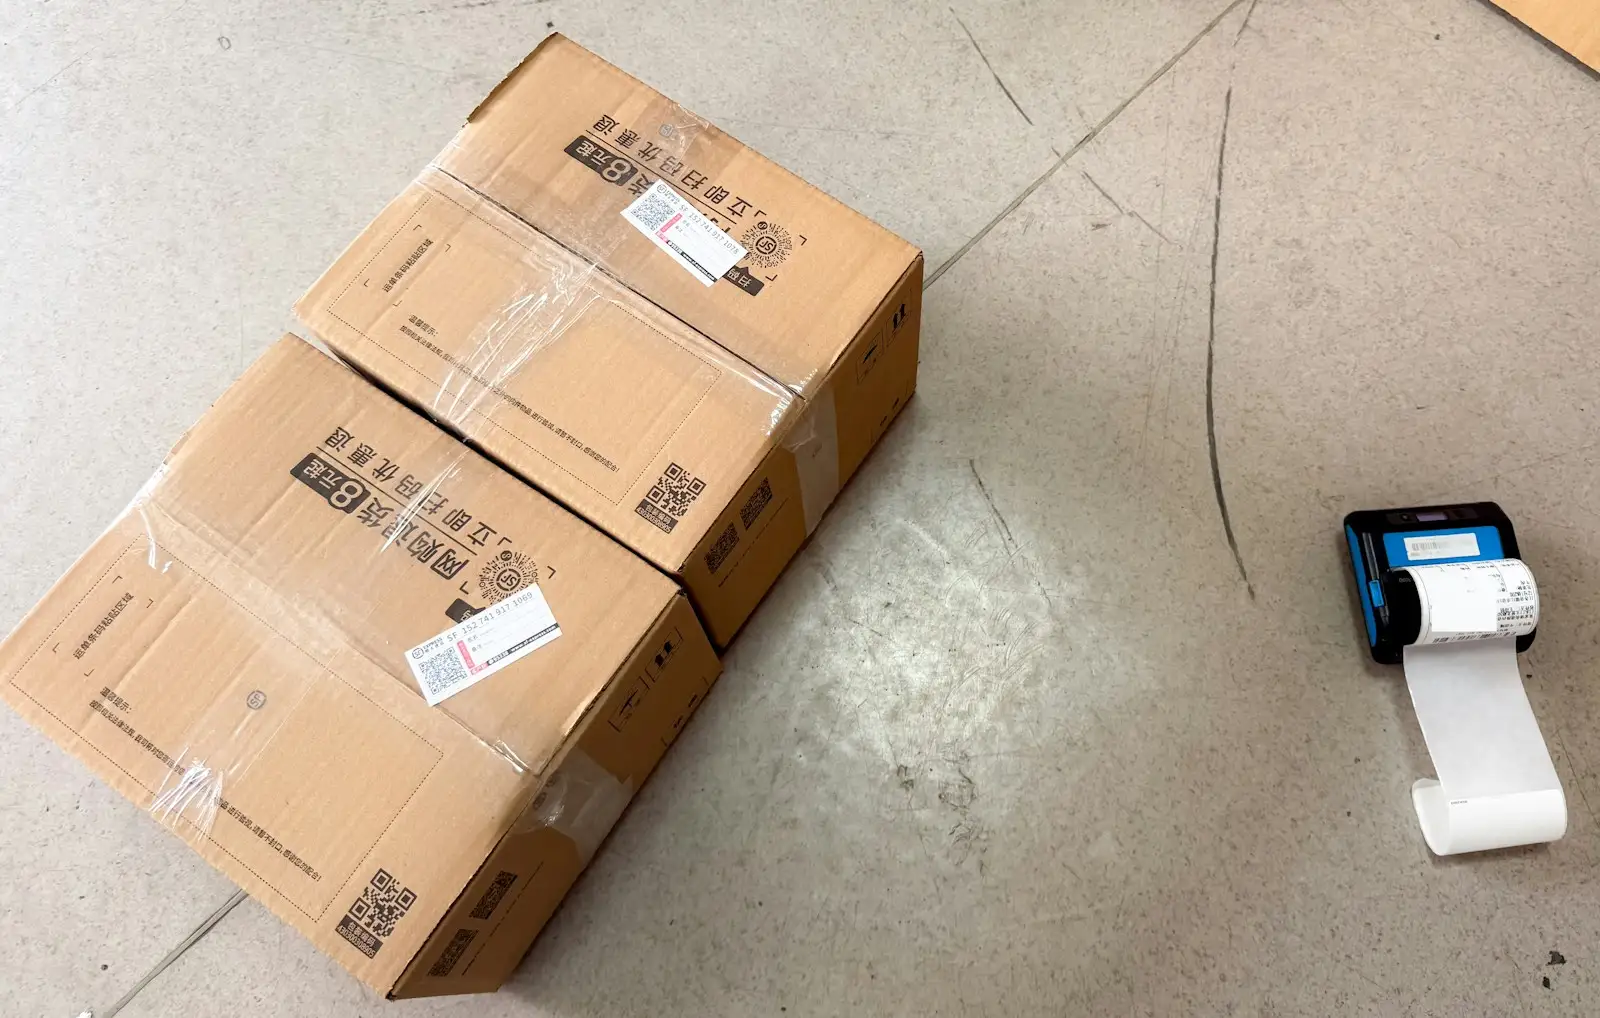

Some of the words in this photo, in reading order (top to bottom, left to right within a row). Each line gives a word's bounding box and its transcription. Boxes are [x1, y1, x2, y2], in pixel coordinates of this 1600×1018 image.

[593, 114, 752, 217] 立即扫码优惠退
[679, 205, 688, 213] SF
[689, 212, 702, 223] 152
[702, 221, 713, 231] 741
[712, 230, 724, 241] 917
[382, 238, 434, 292] 运单条码粘贴区域
[325, 426, 497, 546] 立即扫码优惠退
[645, 504, 671, 524] 包装编码
[73, 592, 134, 660] 运单条码粘贴区域
[447, 633, 458, 642] SF
[462, 622, 478, 633] 152
[478, 614, 494, 624] 741
[495, 604, 510, 616] 917
[513, 592, 533, 606] 1069
[346, 921, 376, 946] 包装编码
